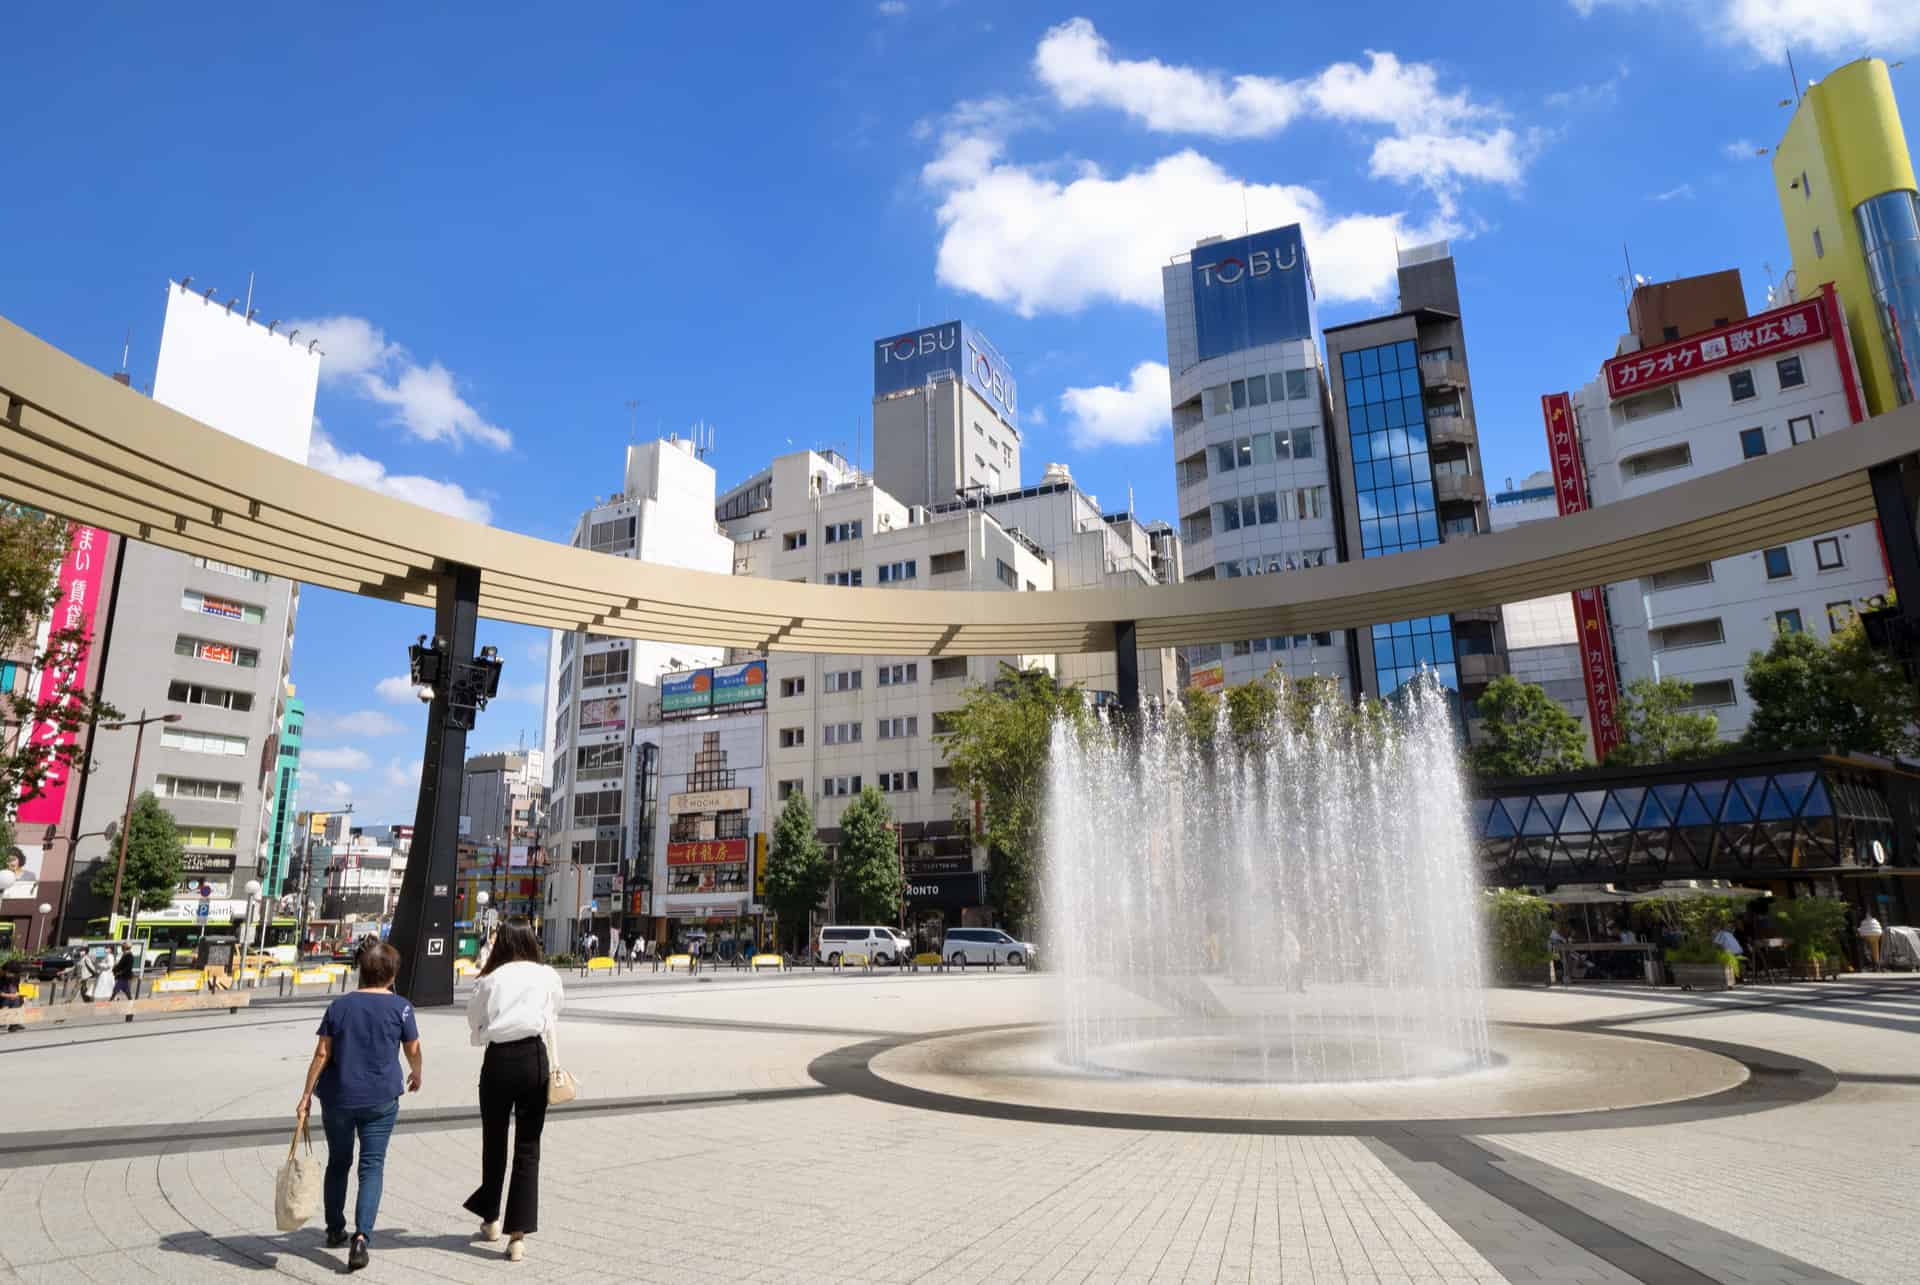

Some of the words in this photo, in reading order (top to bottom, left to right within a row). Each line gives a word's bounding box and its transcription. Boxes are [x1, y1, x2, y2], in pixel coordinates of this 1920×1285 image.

[1197, 243, 1298, 290] TOBU
[878, 327, 956, 361] TOBU
[967, 339, 1016, 417] TOBU
[1618, 346, 1698, 386] カラオケ
[1728, 313, 1809, 354] 歌広場
[1555, 431, 1579, 512] カラオケ
[1588, 650, 1618, 752] カラオケ&パ
[906, 885, 939, 896] RONTO
